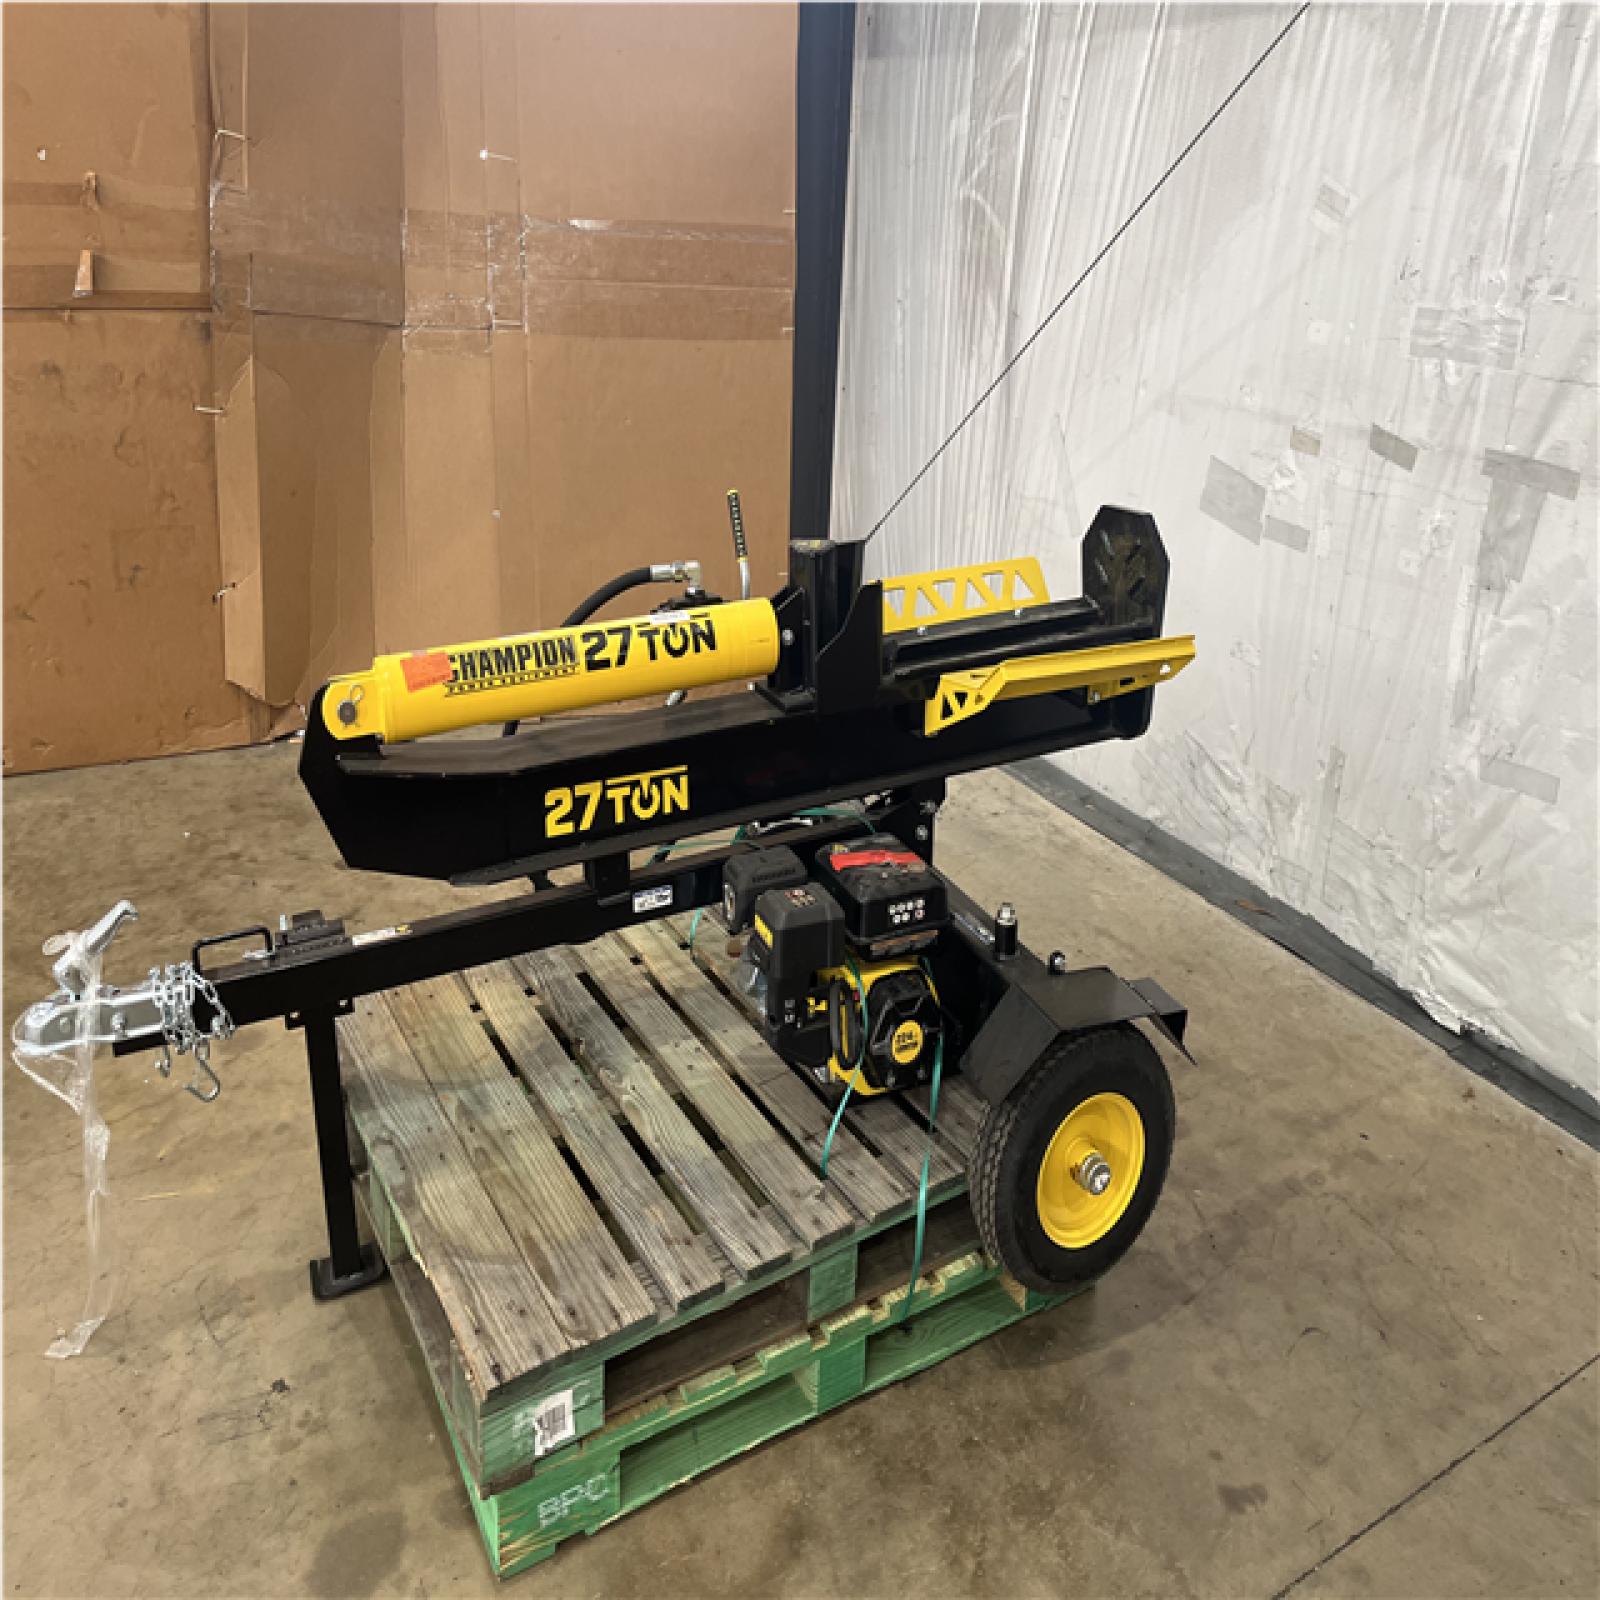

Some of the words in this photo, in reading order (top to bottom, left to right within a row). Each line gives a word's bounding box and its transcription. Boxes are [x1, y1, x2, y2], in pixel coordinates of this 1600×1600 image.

[580, 624, 631, 672] 27
[637, 618, 716, 661] TON
[545, 780, 603, 838] 27
[605, 767, 689, 824] TON
[537, 1472, 609, 1528] BPC
